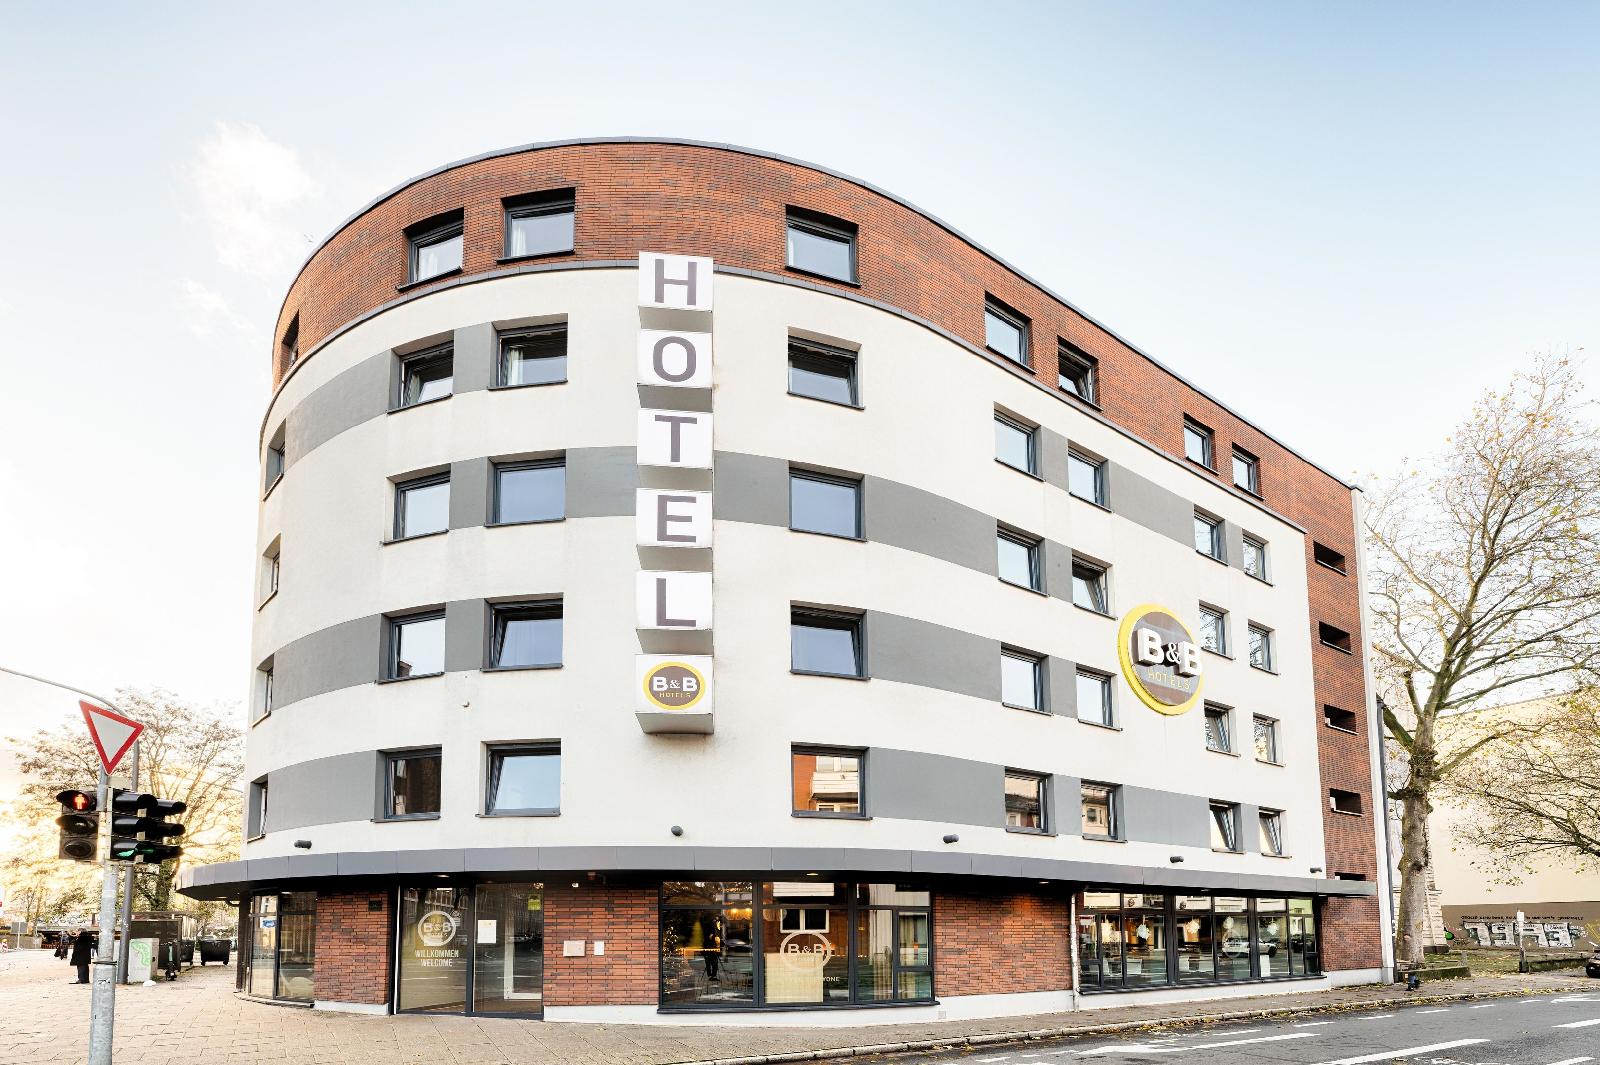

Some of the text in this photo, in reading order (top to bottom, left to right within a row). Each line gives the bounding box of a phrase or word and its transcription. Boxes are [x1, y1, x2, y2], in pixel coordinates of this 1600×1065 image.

[653, 258, 698, 628] HOTEL
[1138, 627, 1202, 677] B&B
[653, 676, 698, 692] B&B
[1148, 670, 1191, 690] HOTELS
[423, 922, 452, 933] B&B
[415, 949, 459, 958] WILLKOMMEN
[420, 959, 453, 967] WELCOME
